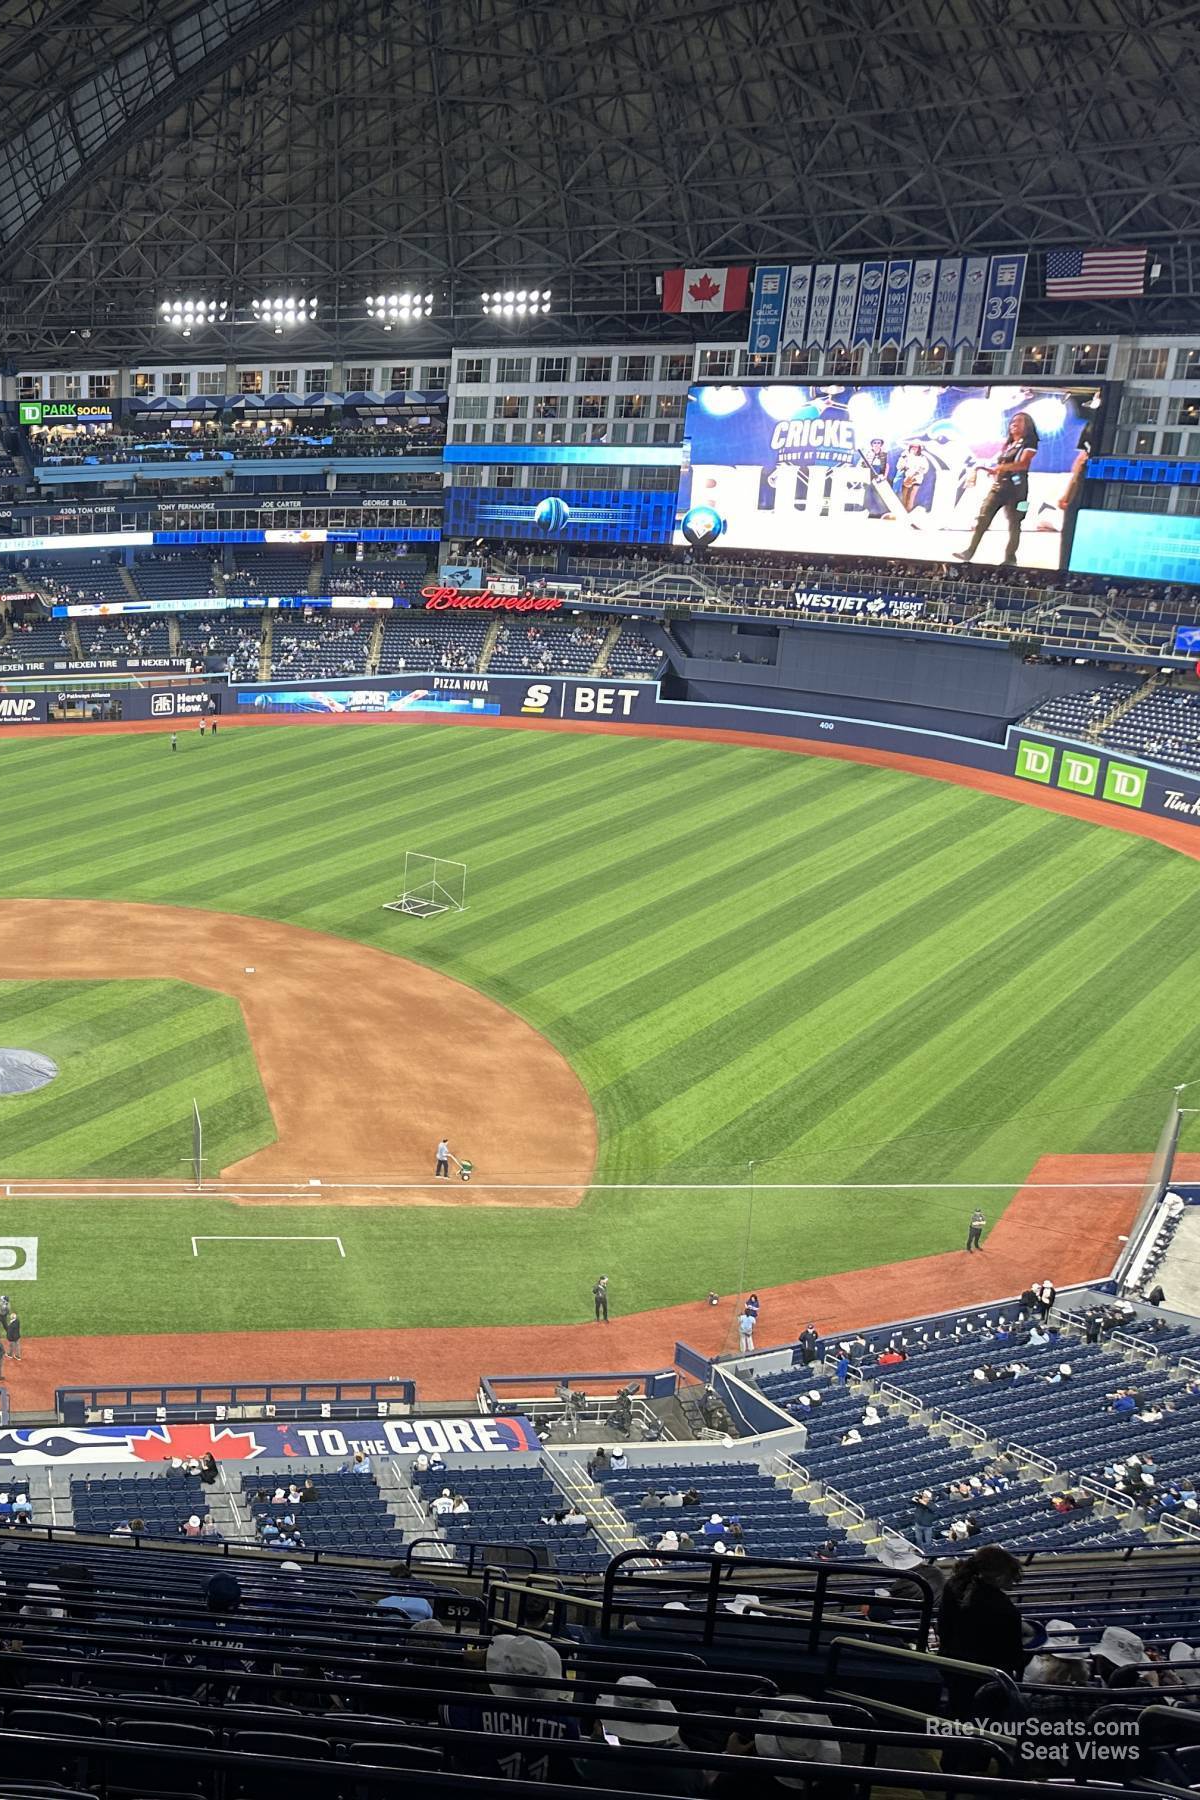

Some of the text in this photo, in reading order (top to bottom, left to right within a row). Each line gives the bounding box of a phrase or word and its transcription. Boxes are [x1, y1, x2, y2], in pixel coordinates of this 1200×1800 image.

[814, 296, 830, 307] 1989
[838, 295, 854, 306] 1991
[862, 294, 878, 306] 1992
[888, 292, 904, 306] 1993
[912, 292, 931, 304] 2015
[986, 296, 1018, 320] 32
[22, 404, 112, 420] TD PARK SOCIAL
[771, 420, 857, 450] CRICKE
[421, 586, 564, 611] Budweiser
[795, 593, 867, 611] WESTJET
[889, 600, 923, 611] FLIGHT
[433, 677, 489, 692] PIZZA NOVA
[177, 692, 208, 703] Here's
[574, 687, 640, 716] BET
[177, 703, 202, 713] How.
[1022, 748, 1049, 774] TD
[1066, 759, 1094, 785] TD
[1111, 769, 1141, 797] TD
[1164, 790, 1190, 813] Tim
[298, 1418, 508, 1456] TO THE CORE
[448, 1606, 470, 1616] 519
